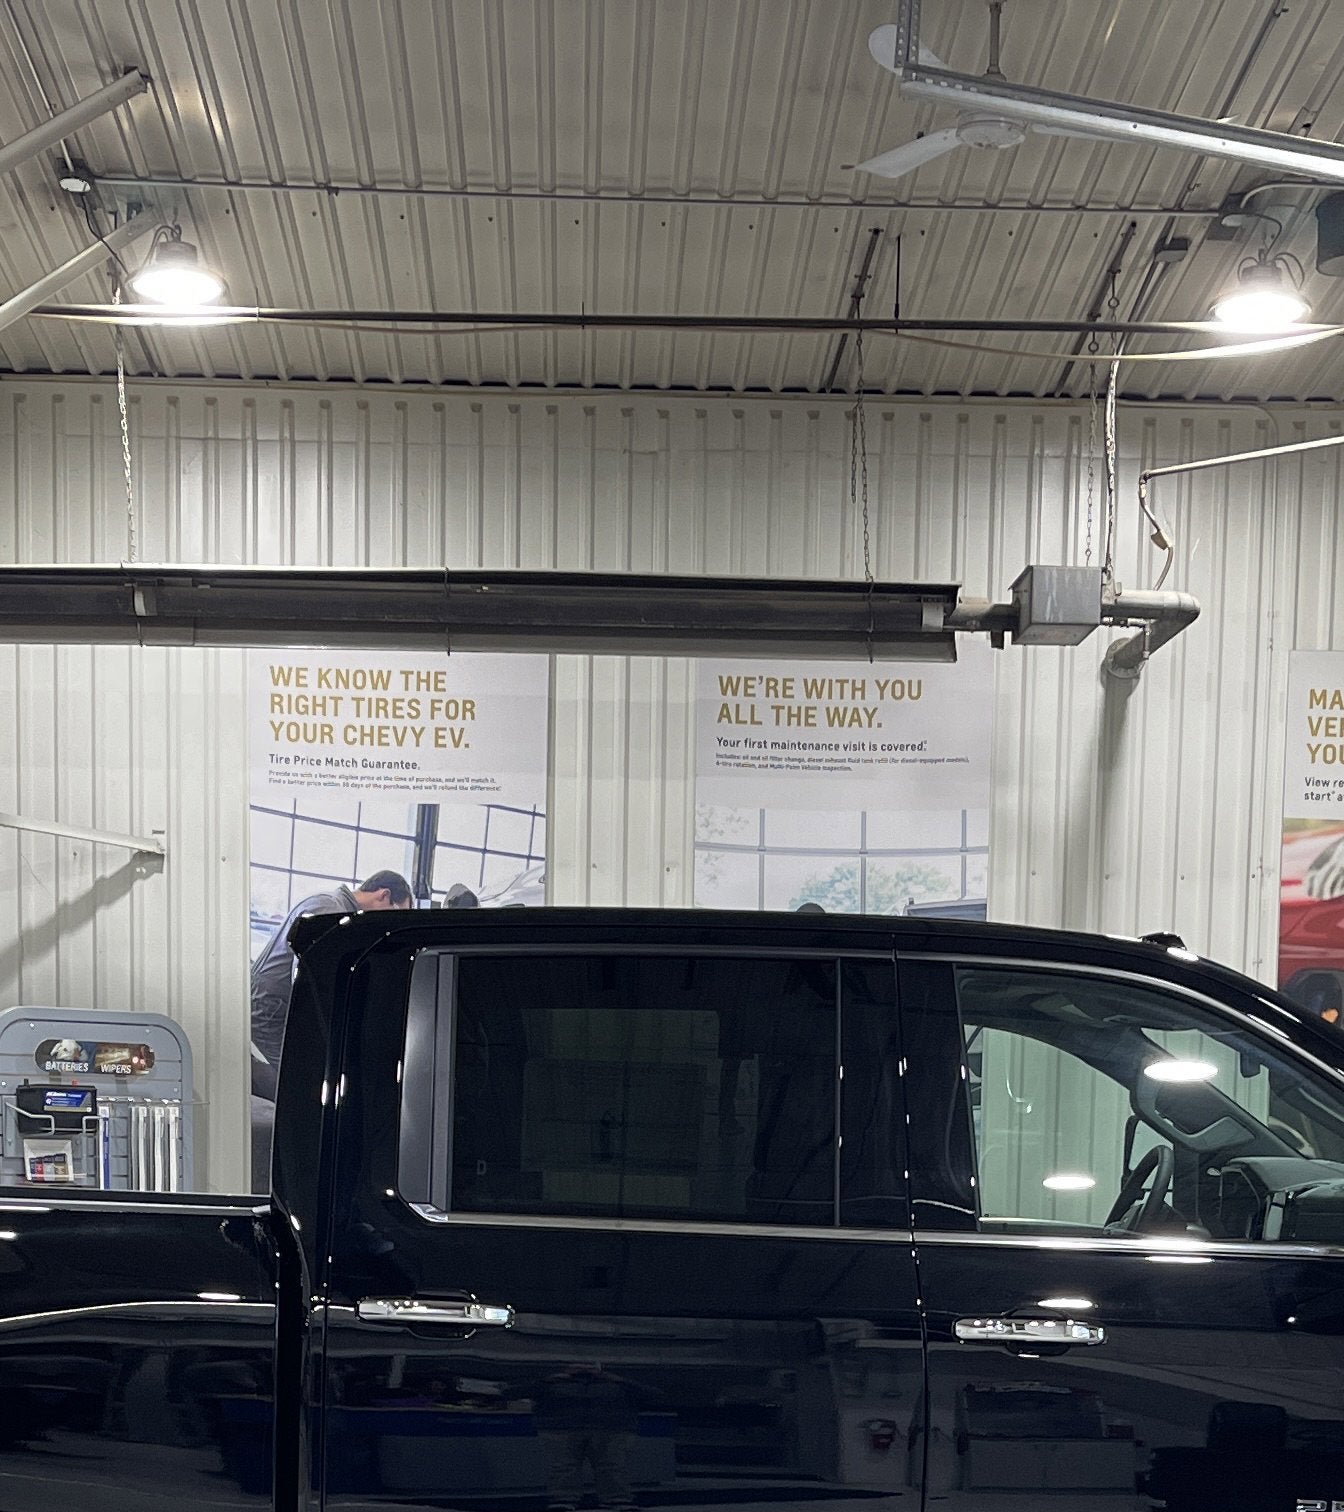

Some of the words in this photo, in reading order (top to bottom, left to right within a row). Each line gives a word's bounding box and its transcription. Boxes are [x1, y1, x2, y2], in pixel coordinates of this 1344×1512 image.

[269, 666, 309, 688] WE
[317, 668, 392, 691] KNOW
[400, 671, 447, 692] THE
[718, 675, 795, 699] WE'RE
[803, 678, 866, 700] WITH
[875, 679, 923, 701] YOU
[270, 693, 344, 717] RIGHT
[351, 697, 421, 720] TIRES
[430, 699, 476, 721] FOR
[717, 703, 763, 725] ALL
[771, 705, 817, 727] THE
[825, 706, 883, 728] WAY.
[269, 720, 334, 744] YOUR
[343, 724, 426, 747] CHEVY
[434, 727, 470, 749] EV.
[717, 737, 741, 748] Your
[744, 738, 767, 749] first
[771, 740, 840, 751] maintenance
[843, 740, 865, 752] visit
[869, 741, 878, 752] is
[269, 754, 290, 765] Tire
[294, 755, 321, 767] Price
[325, 756, 358, 769] Match
[361, 759, 421, 770] Guarantee.
[1304, 777, 1330, 788] View
[45, 1061, 89, 1073] BATTERIES
[101, 1064, 131, 1074] WIPERS
